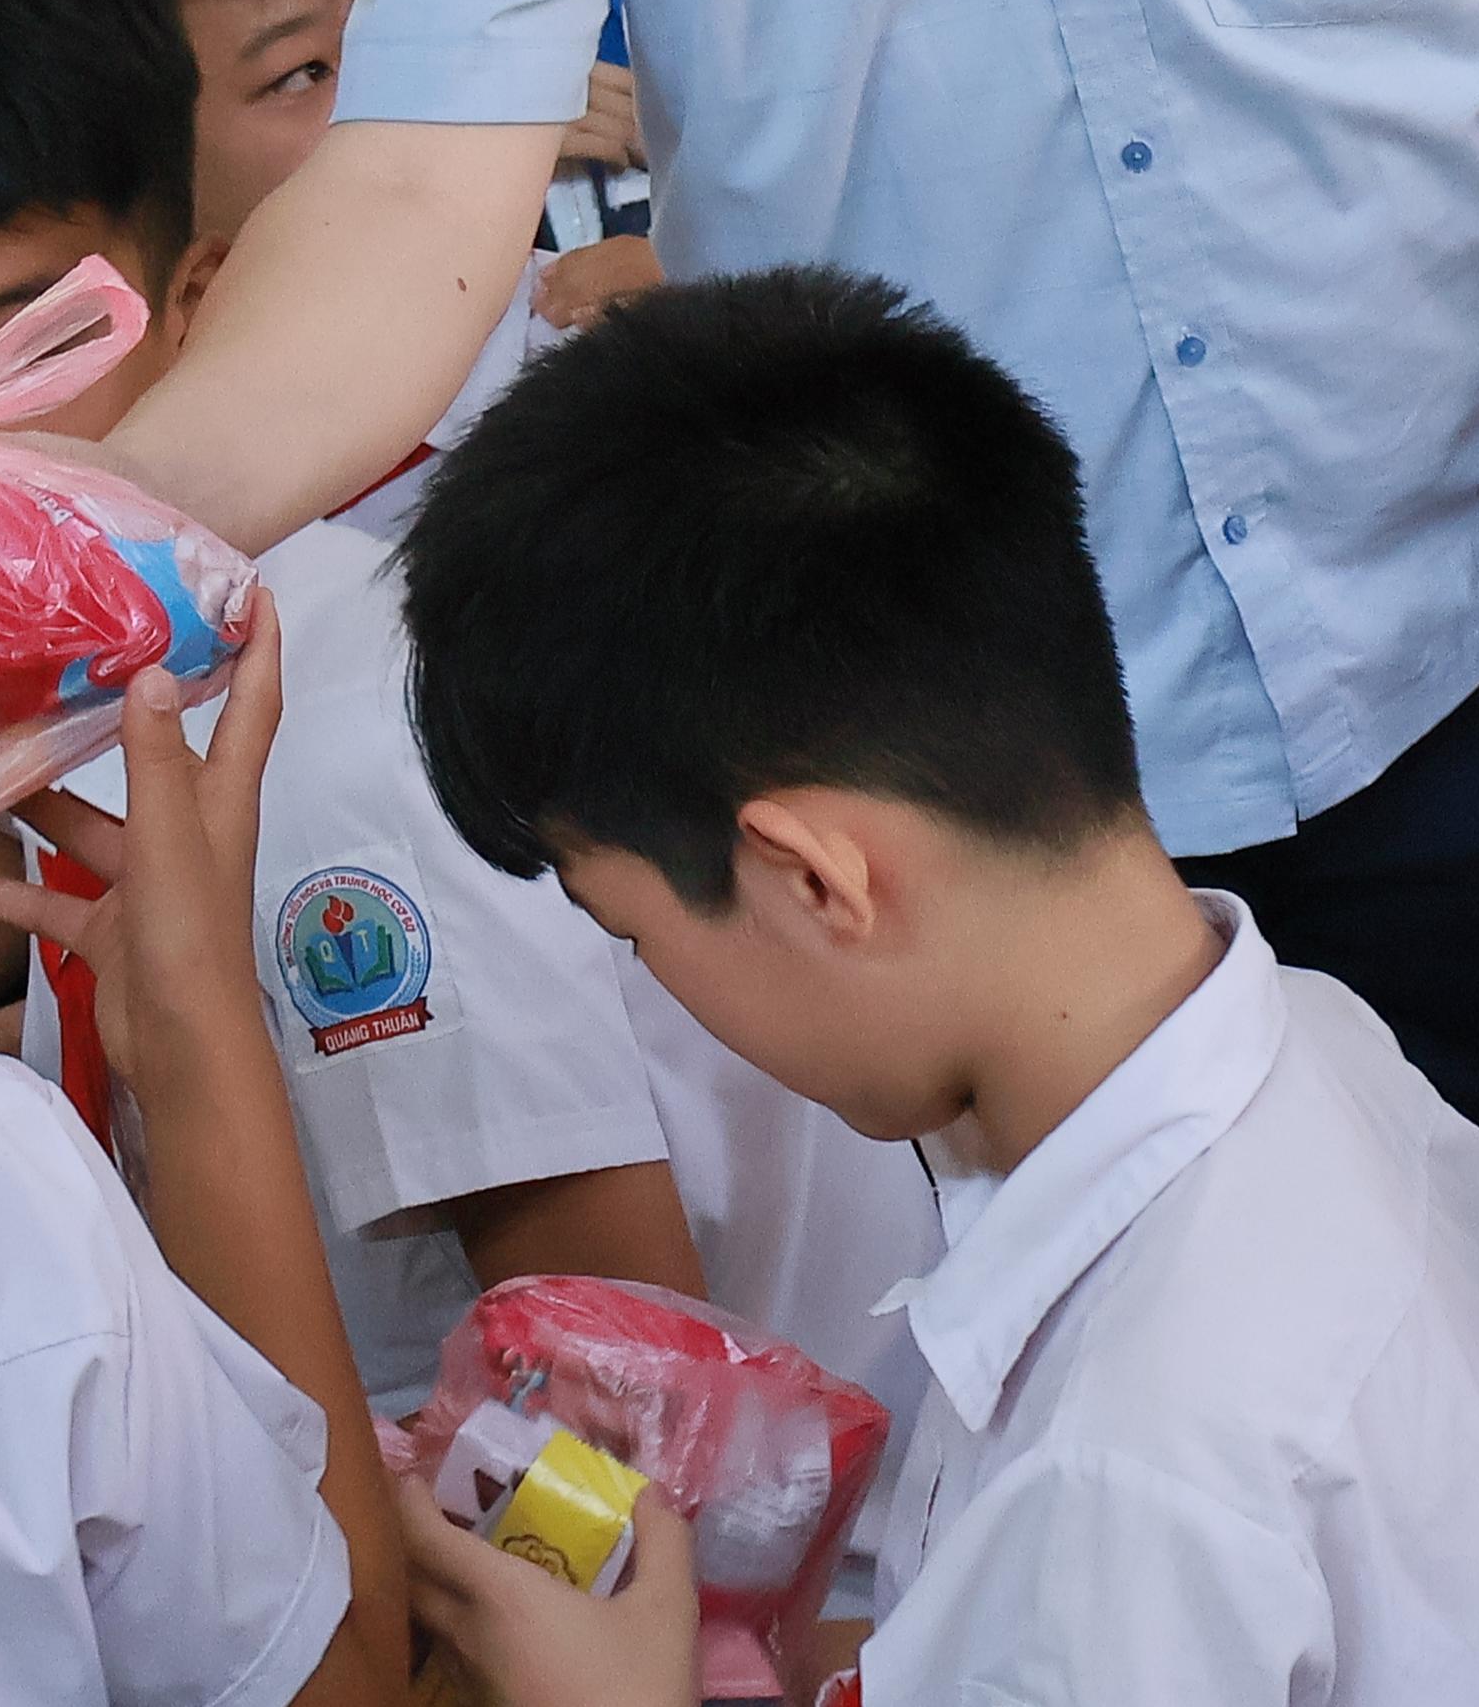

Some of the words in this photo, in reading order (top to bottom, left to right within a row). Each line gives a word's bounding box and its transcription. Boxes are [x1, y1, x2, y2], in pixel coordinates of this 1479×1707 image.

[333, 875, 369, 890] TRUNG
[319, 939, 335, 964] Q
[355, 928, 369, 953] T
[324, 1023, 370, 1052] QUANG
